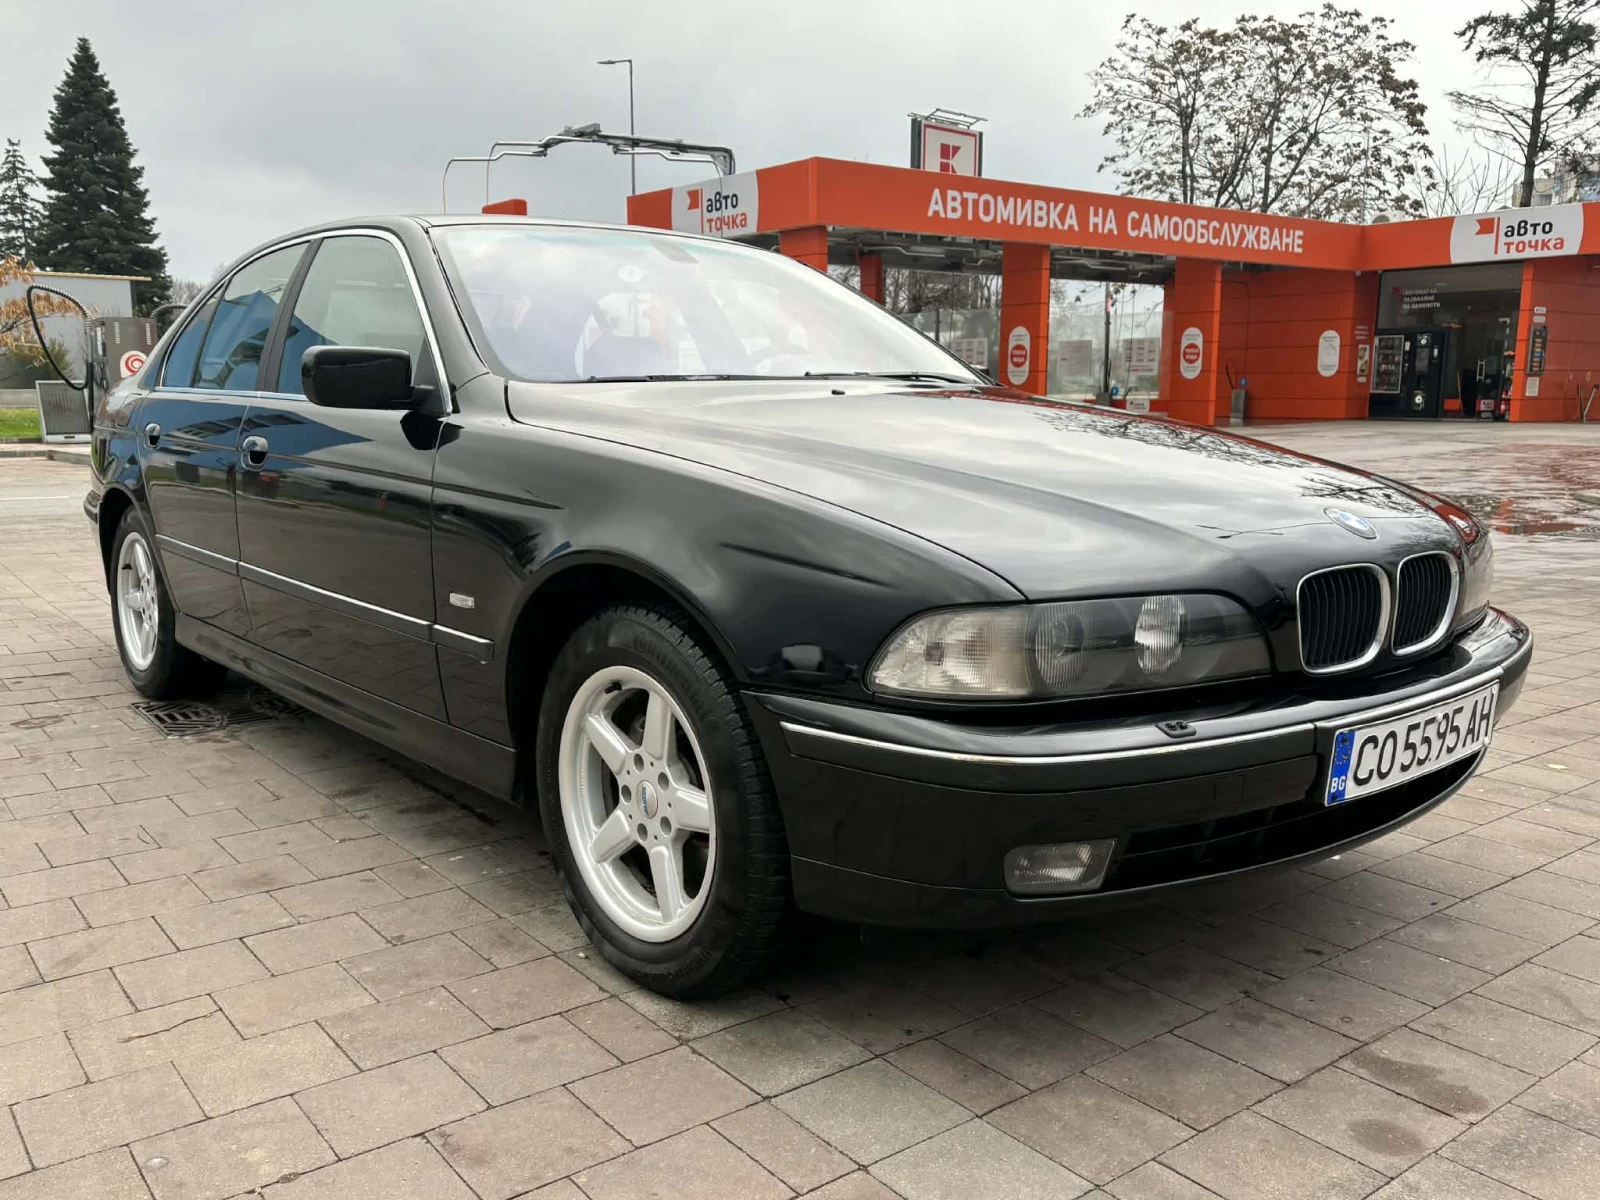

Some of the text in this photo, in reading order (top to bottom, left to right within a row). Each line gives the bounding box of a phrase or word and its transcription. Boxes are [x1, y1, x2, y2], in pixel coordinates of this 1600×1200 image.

[706, 191, 739, 213] авто
[706, 212, 748, 233] точка
[927, 188, 1305, 254] АВТОМИВКА НА САМООБСЛУЖВАНЕ
[1504, 219, 1554, 238] авто
[1503, 237, 1565, 254] точка
[1330, 776, 1346, 793] BG
